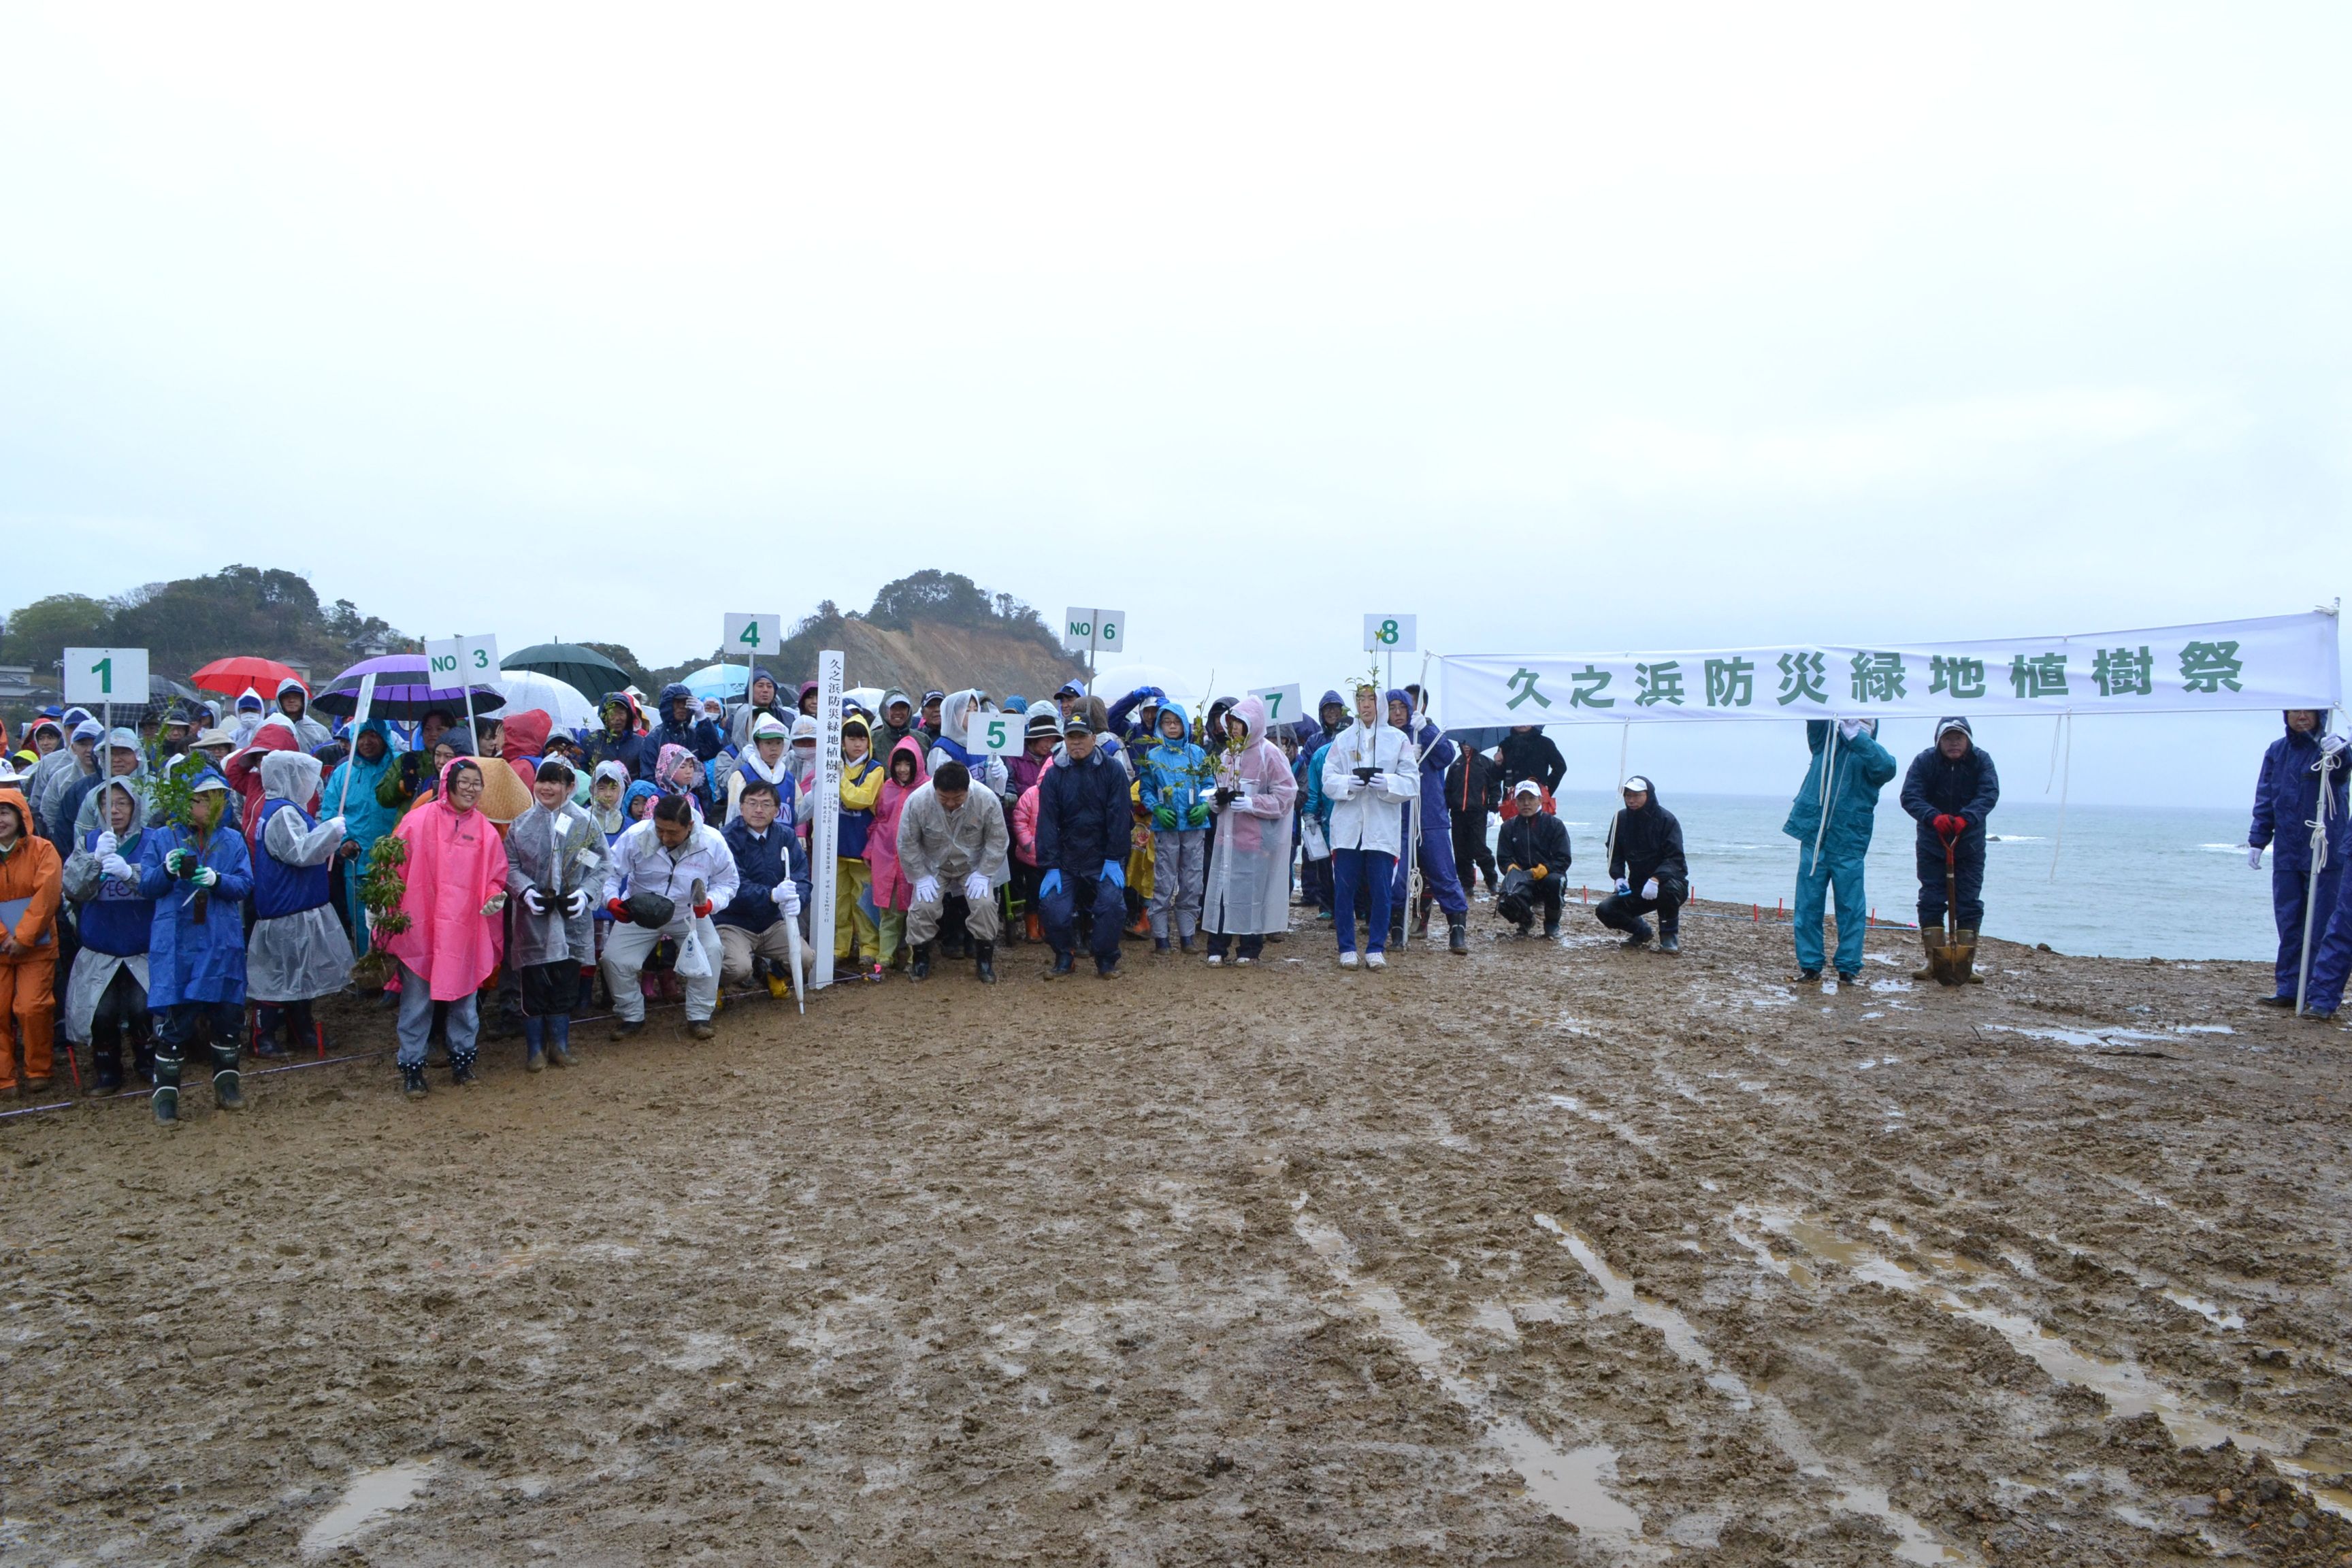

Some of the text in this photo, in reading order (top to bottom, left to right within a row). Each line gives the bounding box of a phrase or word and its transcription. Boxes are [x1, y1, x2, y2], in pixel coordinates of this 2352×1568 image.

[739, 620, 762, 649] 4
[1070, 622, 1116, 640] NO 6
[1381, 619, 1399, 644] 8
[431, 648, 490, 673] NO 3
[1506, 640, 2244, 708] 久之浜防災緑地植樹祭
[91, 657, 112, 694] 1
[1264, 693, 1283, 719] 7
[825, 659, 842, 784] 久之浜防災緑地植樹祭
[985, 720, 1007, 749] 5
